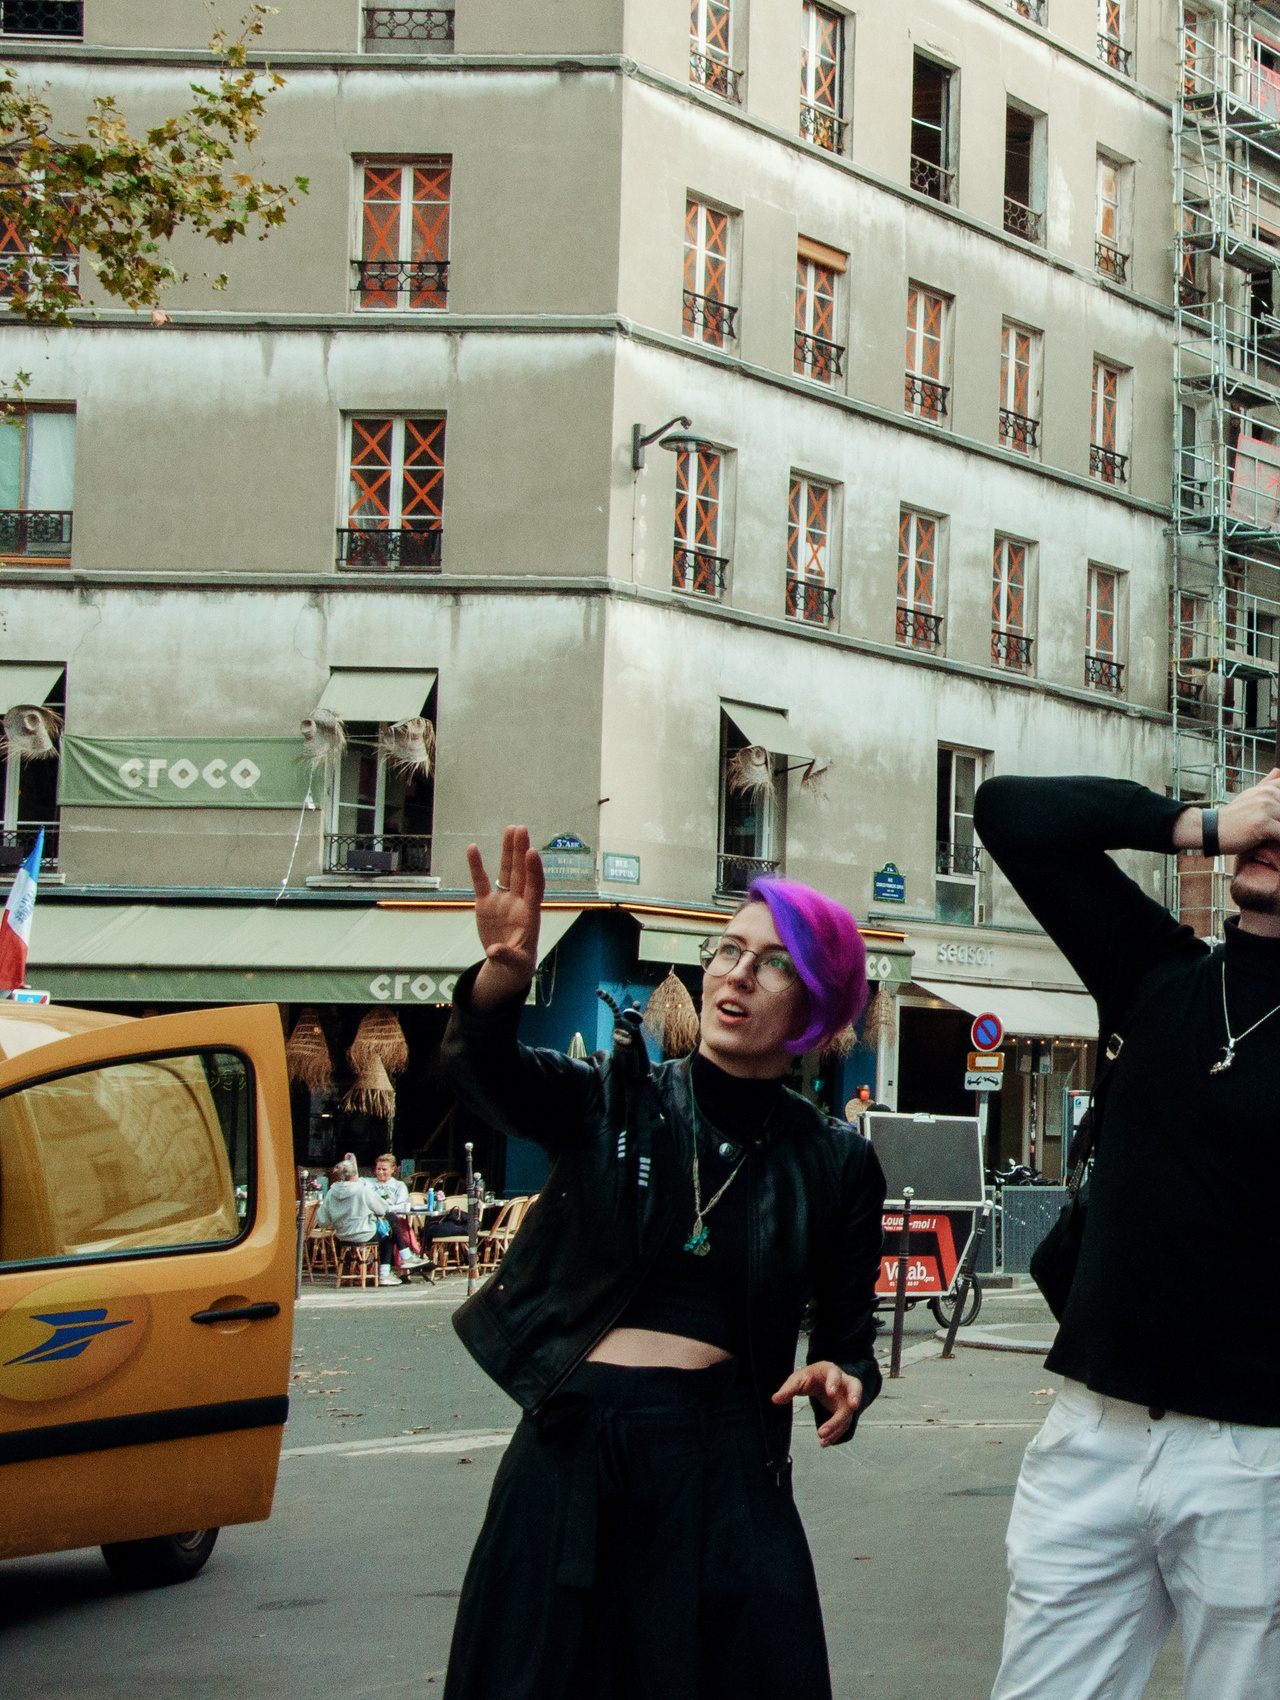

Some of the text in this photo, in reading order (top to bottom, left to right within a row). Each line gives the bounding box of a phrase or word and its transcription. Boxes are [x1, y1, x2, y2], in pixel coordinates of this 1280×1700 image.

[118, 758, 261, 789] croco
[615, 859, 629, 868] RUE
[866, 955, 891, 978] co
[369, 974, 459, 1000] croc
[881, 1215, 931, 1229] Loue-moi
